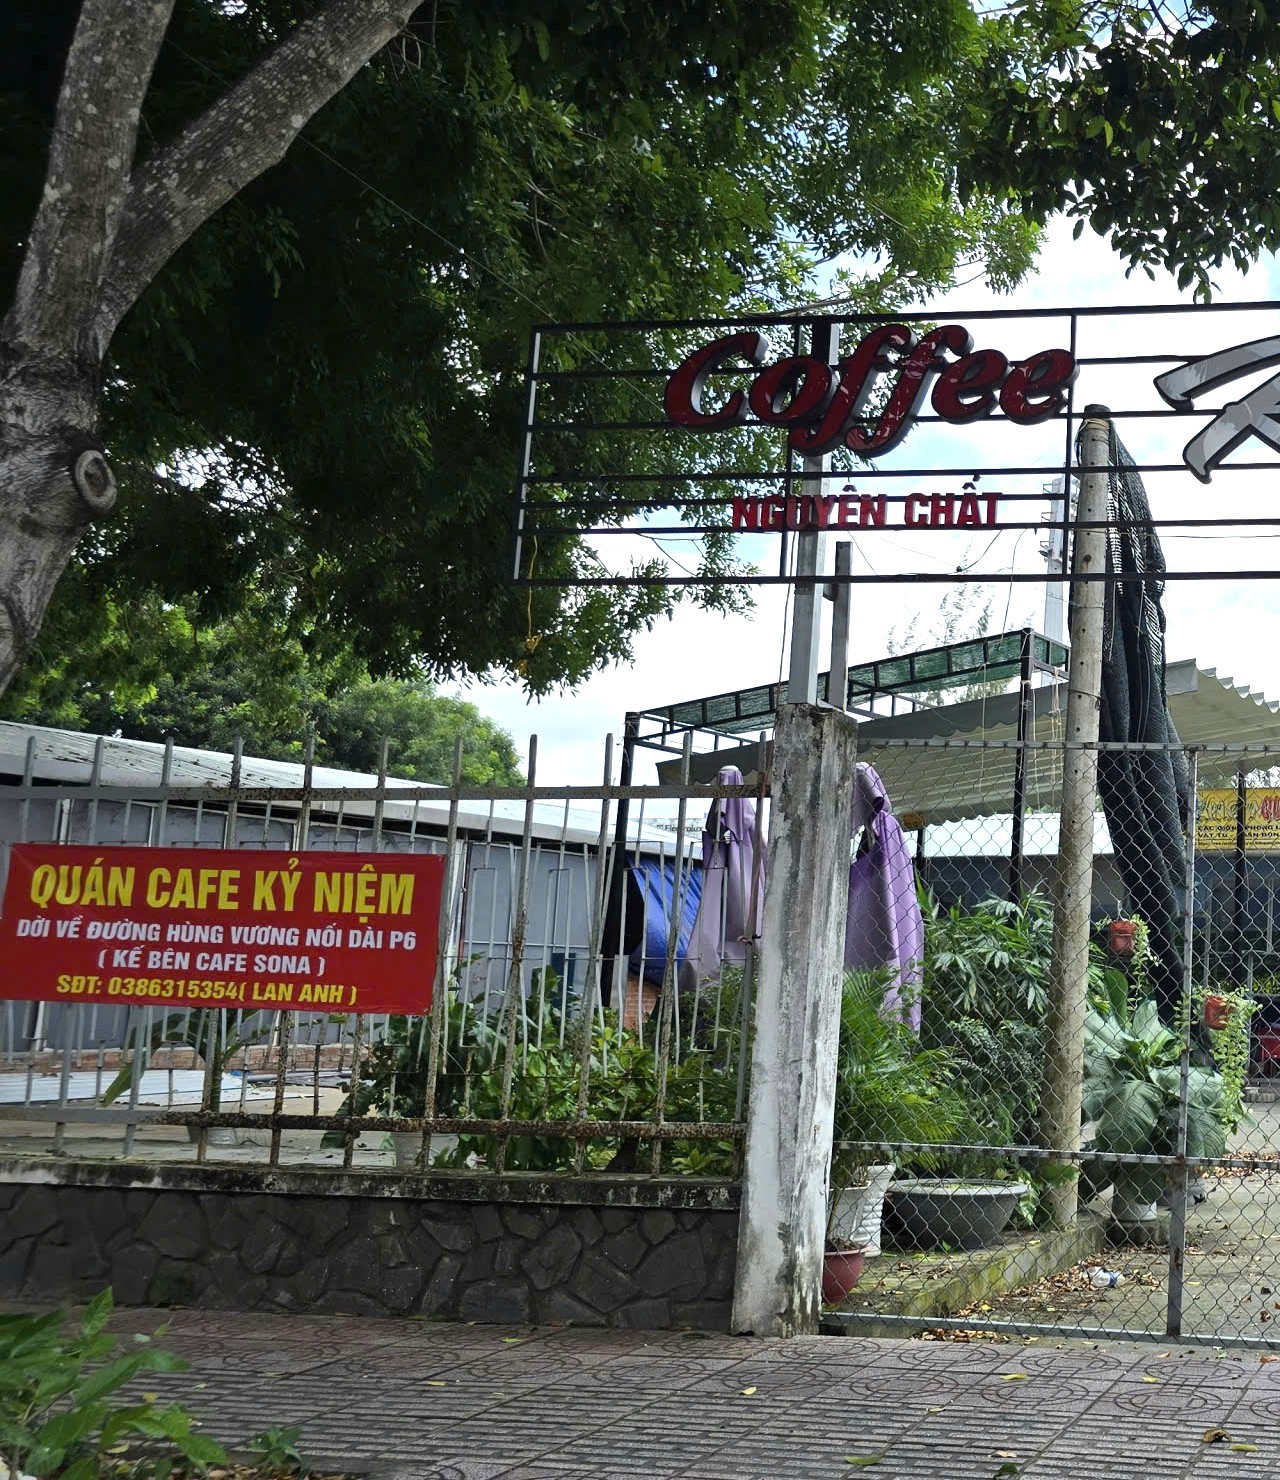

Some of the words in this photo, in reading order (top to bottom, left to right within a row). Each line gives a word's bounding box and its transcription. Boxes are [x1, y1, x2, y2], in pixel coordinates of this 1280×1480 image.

[664, 324, 1080, 457] Coffee
[732, 484, 888, 530] NGUYÊN
[904, 474, 1003, 529] CHẤT
[30, 858, 135, 909] QUÁN
[146, 867, 241, 910] CAFE
[253, 857, 302, 912] KỶ
[313, 864, 416, 923] NIỆM
[16, 915, 51, 938] DỜI
[56, 915, 83, 940] VỀ
[86, 918, 161, 942] ĐƯỜNG
[166, 921, 224, 944] HÙNG
[231, 925, 300, 946] VƯƠNG
[305, 922, 342, 948] NỐI
[348, 926, 383, 949] DÀI
[389, 931, 417, 950] P6
[112, 945, 145, 968] KẾ
[147, 948, 190, 970] BÊN
[196, 952, 247, 973] CAFE
[253, 954, 311, 974] SONA
[56, 975, 101, 995] SĐT:
[252, 982, 294, 1001] LAN
[298, 984, 344, 1003] ANH
